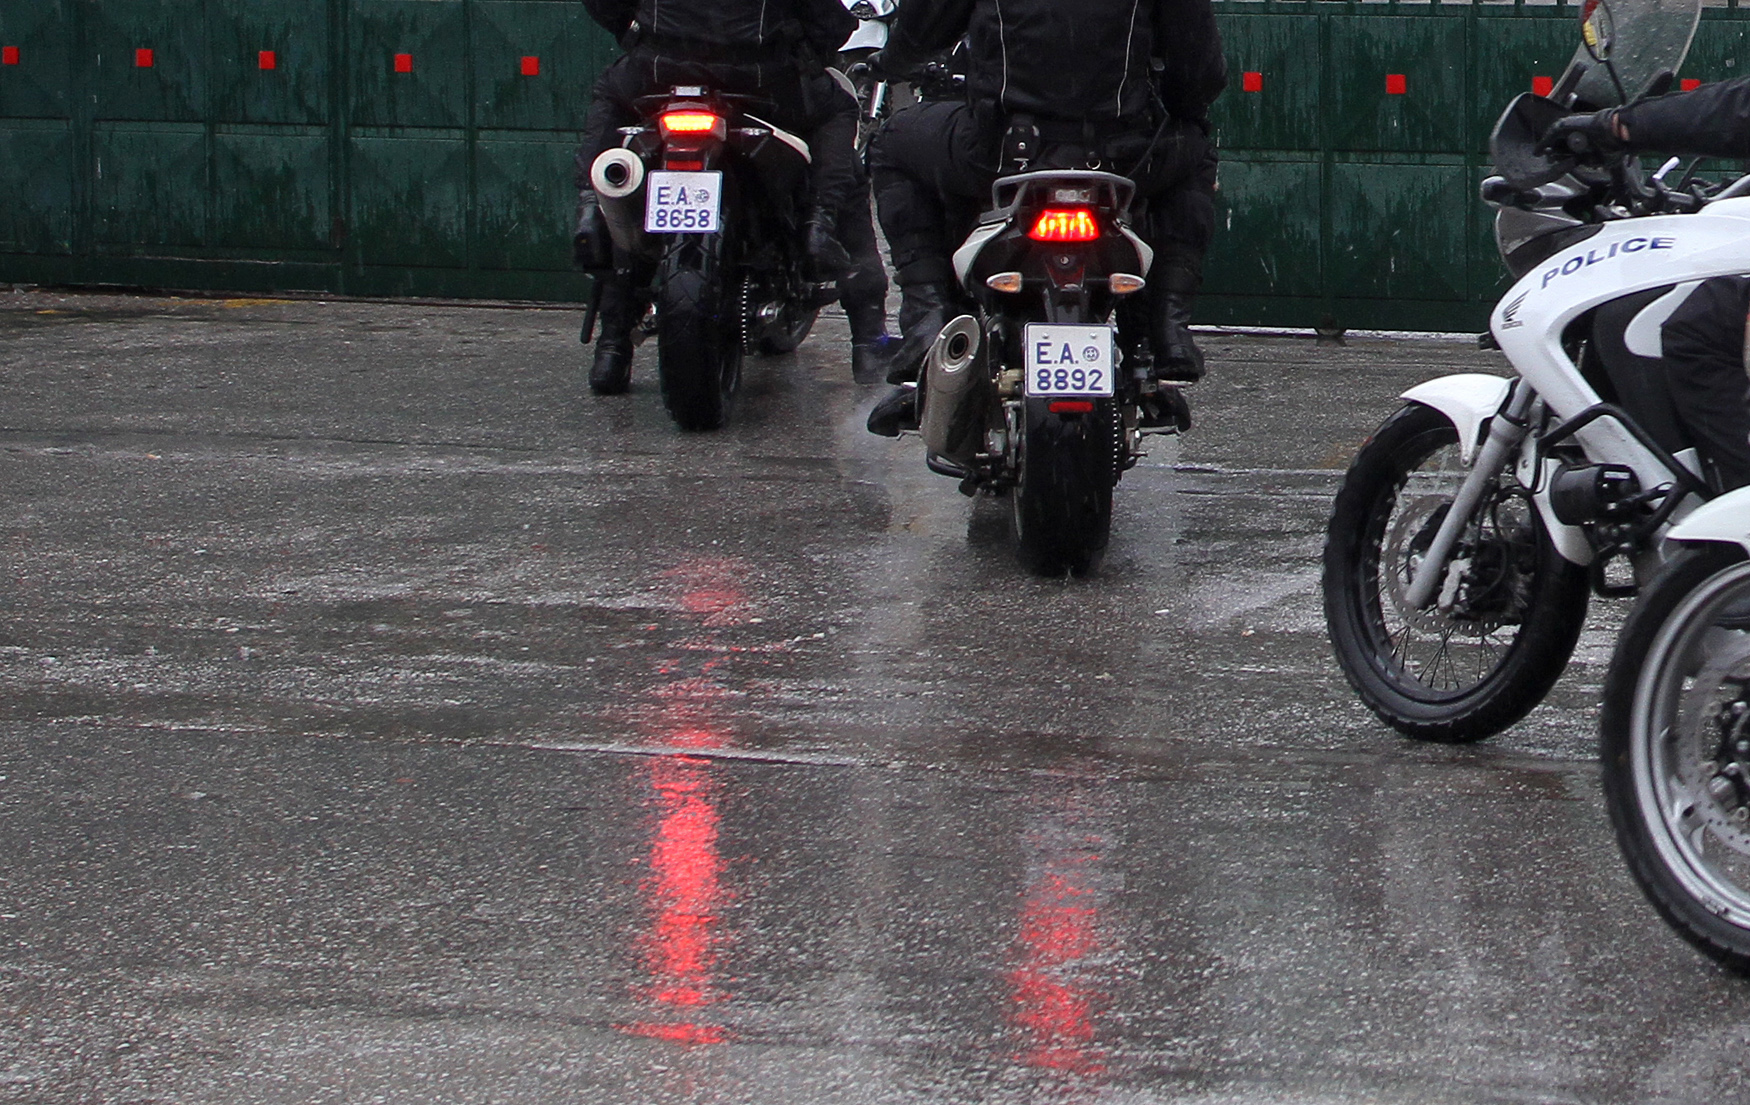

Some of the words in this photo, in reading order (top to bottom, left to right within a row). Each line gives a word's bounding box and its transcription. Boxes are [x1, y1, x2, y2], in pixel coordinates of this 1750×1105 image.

[655, 209, 710, 228] 8658
[1541, 237, 1677, 290] POLICE
[1037, 368, 1103, 391] 8892
